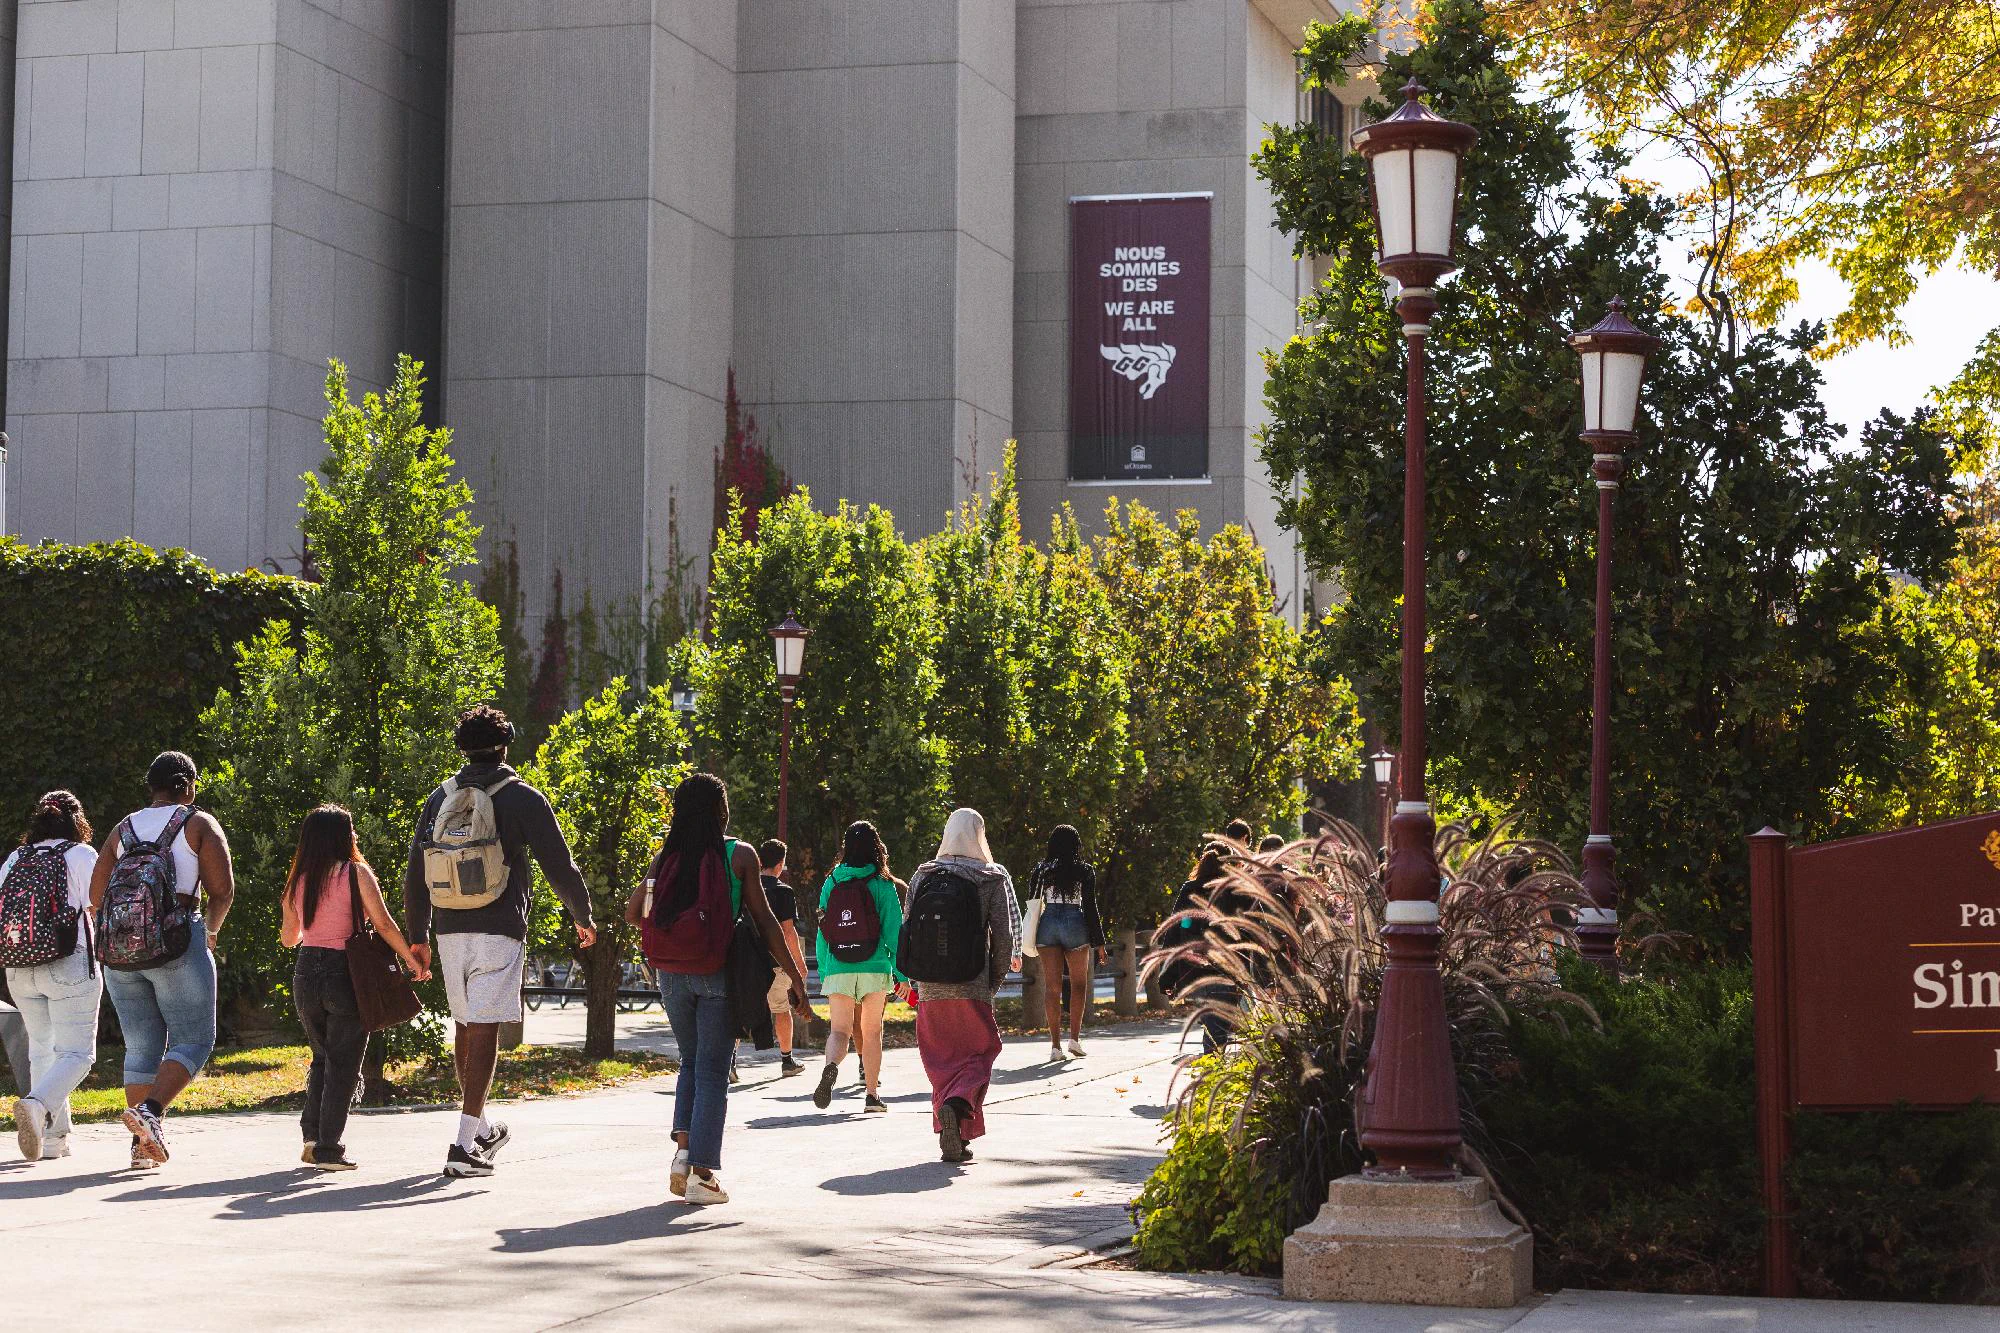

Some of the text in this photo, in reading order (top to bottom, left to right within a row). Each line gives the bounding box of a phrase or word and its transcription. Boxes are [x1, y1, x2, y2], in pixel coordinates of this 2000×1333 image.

[1115, 246, 1166, 261] NOUS
[1100, 261, 1180, 277] SOMMES
[1122, 278, 1158, 292] DES
[1104, 300, 1175, 316] WE ARE
[1122, 317, 1157, 331] ALL
[1115, 356, 1150, 373] GG
